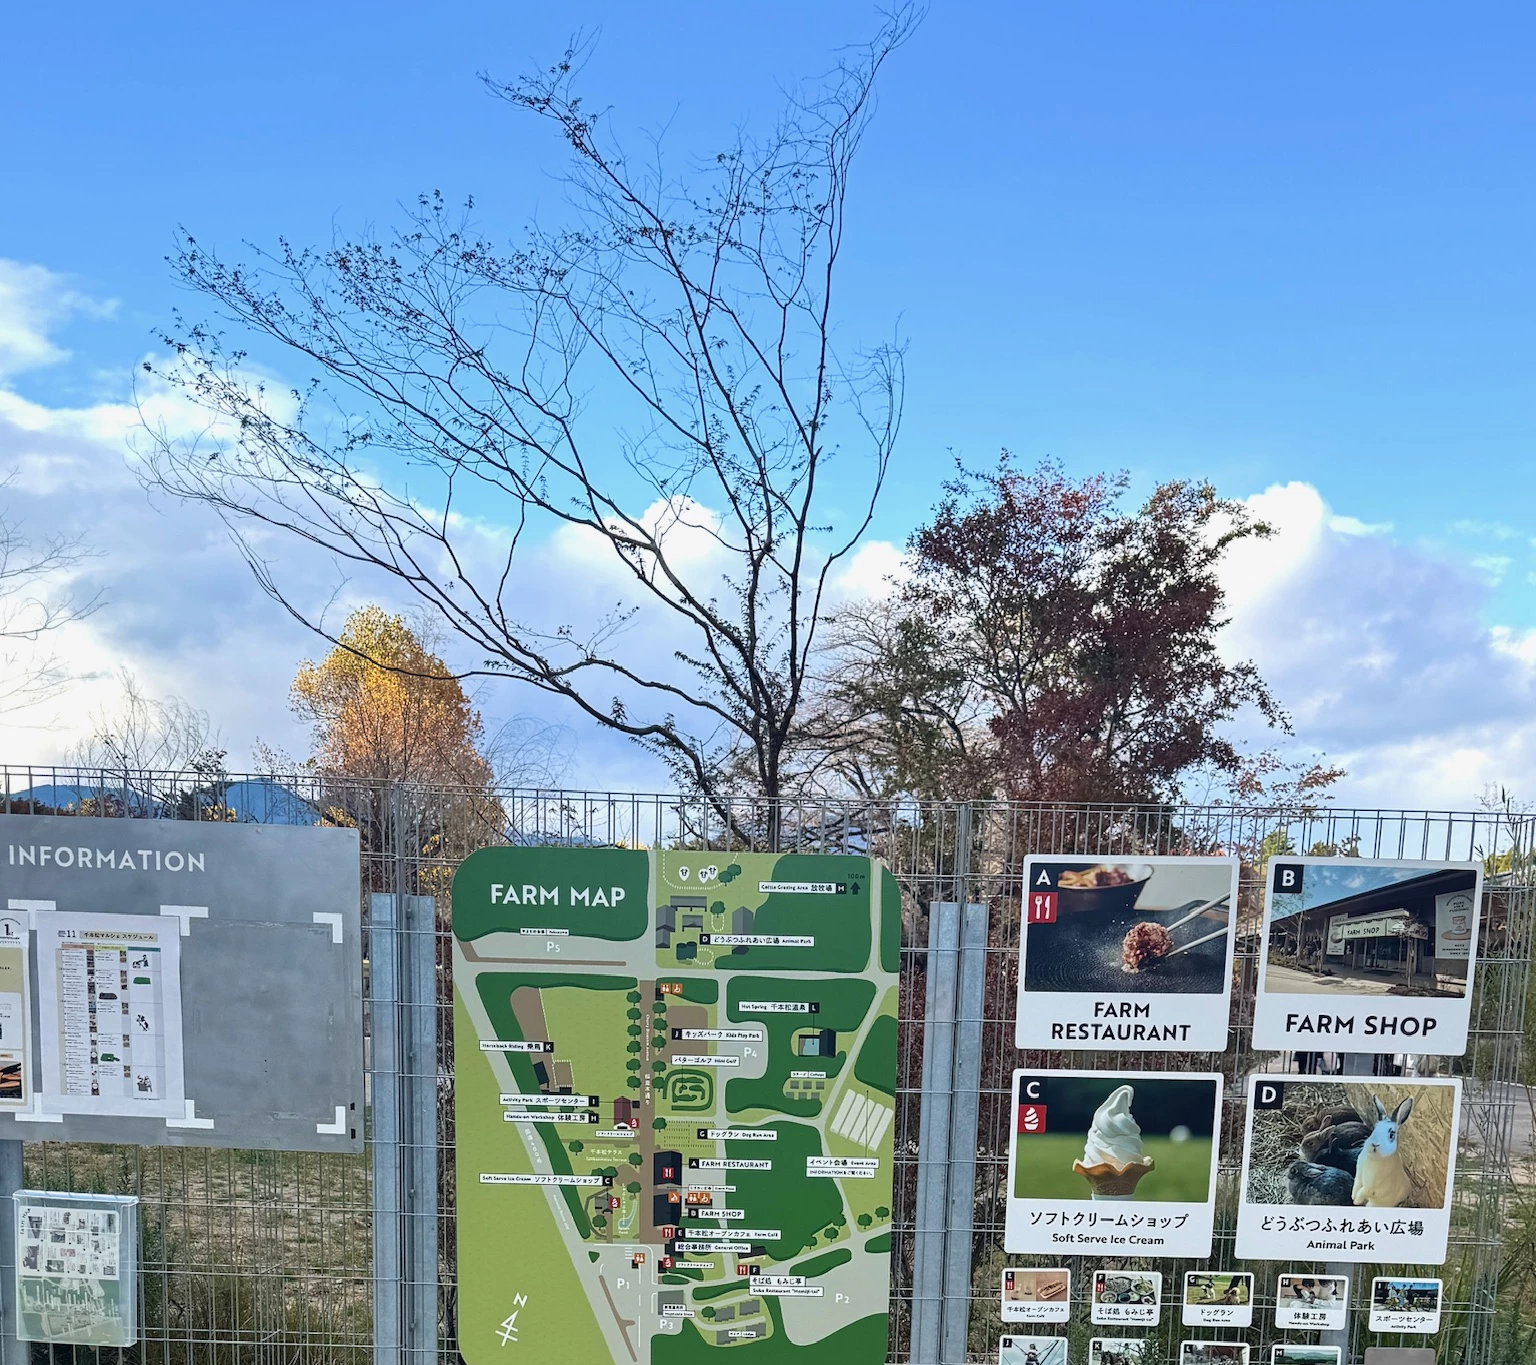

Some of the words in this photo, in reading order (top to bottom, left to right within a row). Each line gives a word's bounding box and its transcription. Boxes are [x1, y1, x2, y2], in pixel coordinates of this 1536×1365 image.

[8, 844, 205, 872] INFORMATION
[1036, 869, 1051, 885] A
[1282, 870, 1295, 887] B
[491, 884, 559, 906] FARM
[571, 887, 625, 907] MAP
[547, 941, 560, 952] P5
[714, 936, 780, 944] どうぶつふれあい広場
[1094, 1002, 1150, 1017] FARM
[1052, 1023, 1191, 1041] RESTAURANT
[1286, 1014, 1354, 1034] FARM
[1364, 1016, 1437, 1037] SHOP
[744, 1047, 758, 1058] P4
[1026, 1081, 1040, 1099] C
[1261, 1086, 1276, 1103] D
[1030, 1211, 1189, 1229] ソフトクリームショップ
[1261, 1216, 1424, 1236] どうぶつふれあい広場
[1052, 1233, 1075, 1243] Soft
[1077, 1234, 1107, 1244] Serve
[1110, 1235, 1125, 1244] Ice
[1129, 1236, 1164, 1245] Cream
[1307, 1240, 1346, 1250] Animal
[1350, 1241, 1375, 1251] Park
[617, 1278, 629, 1289] P1
[513, 1292, 528, 1308] N
[836, 1293, 850, 1303] P2
[1293, 1312, 1326, 1320] 体験工房
[659, 1319, 674, 1330] P3
